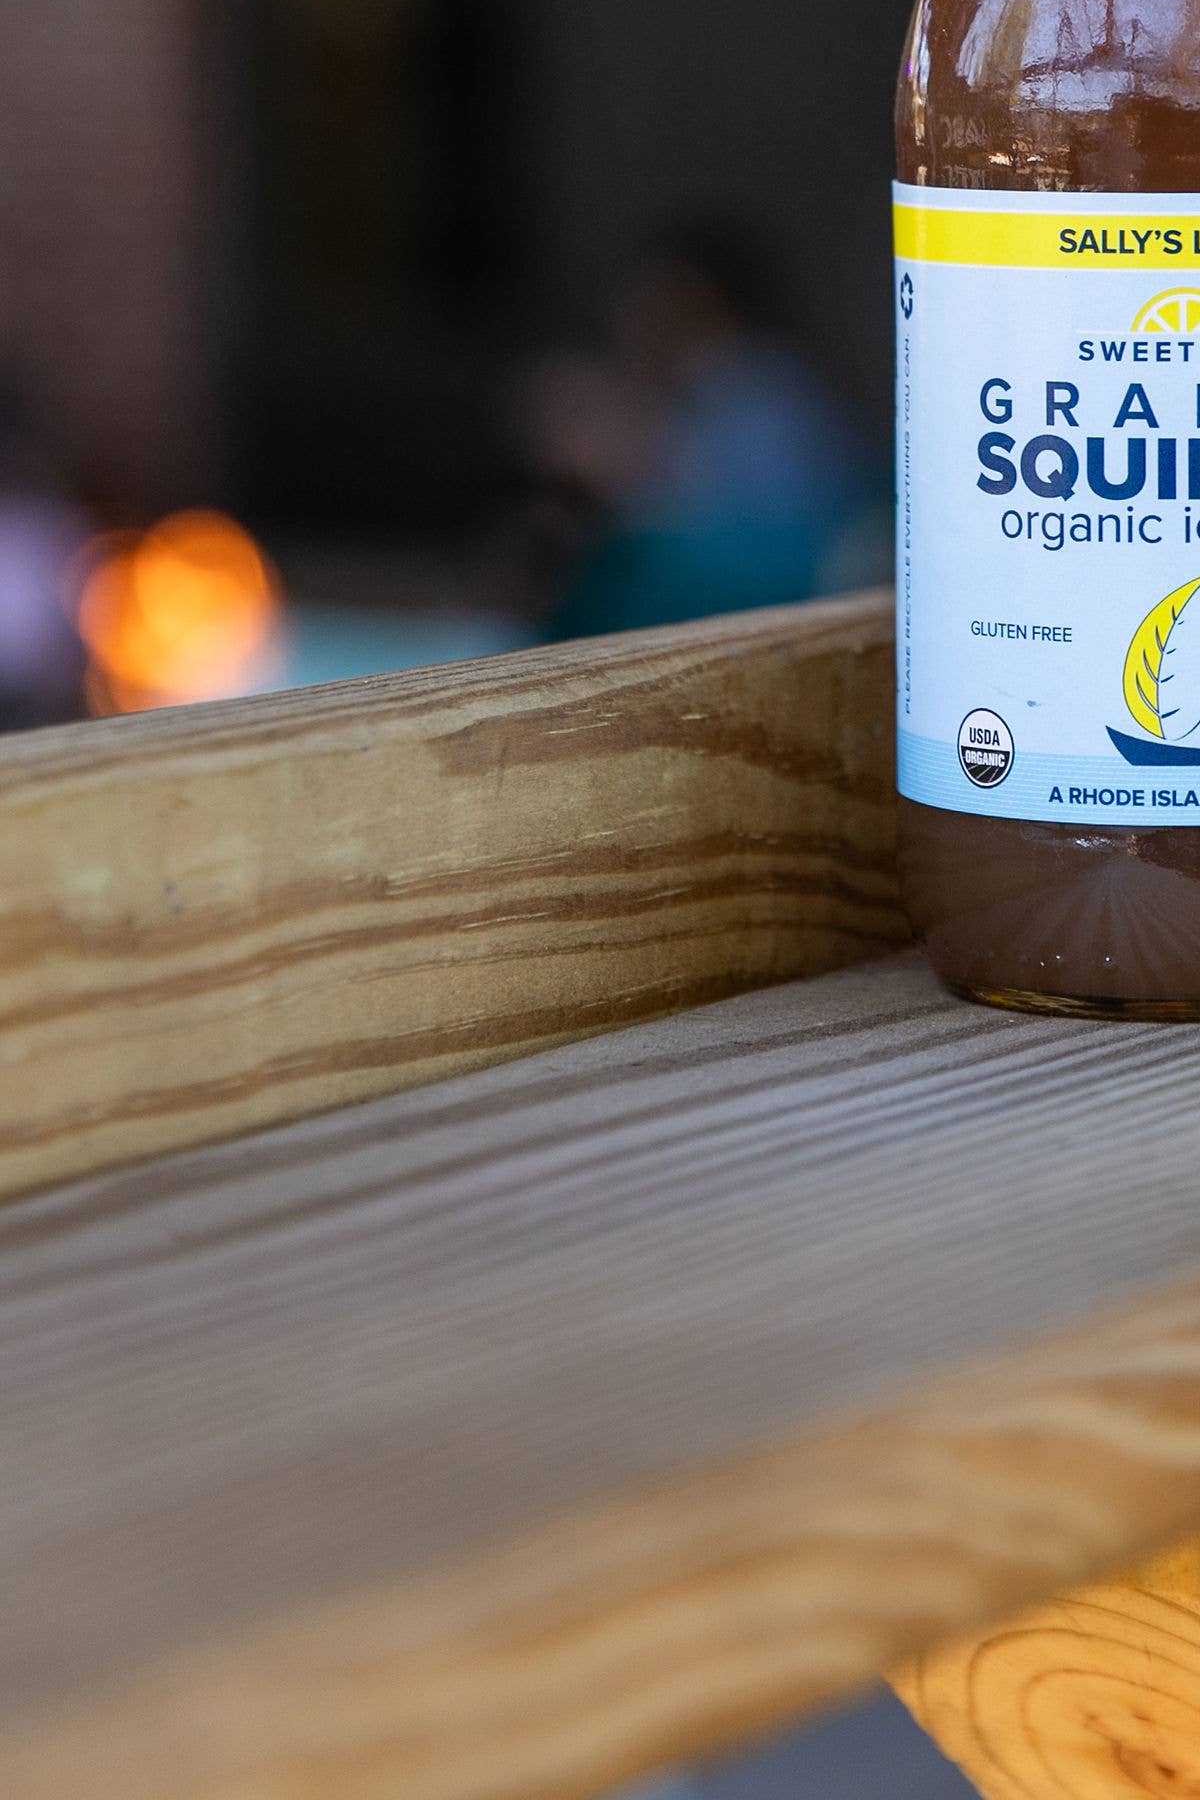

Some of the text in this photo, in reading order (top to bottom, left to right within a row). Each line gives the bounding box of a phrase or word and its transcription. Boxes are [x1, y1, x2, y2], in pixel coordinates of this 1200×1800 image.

[1059, 228, 1183, 254] SALLY'S
[1001, 506, 1162, 551] organic
[970, 620, 1073, 643] GLUTEN FREE
[969, 726, 1000, 746] USDA
[965, 749, 1006, 768] ORGANIC
[1049, 786, 1063, 803] A
[1068, 787, 1145, 806] RHODE
